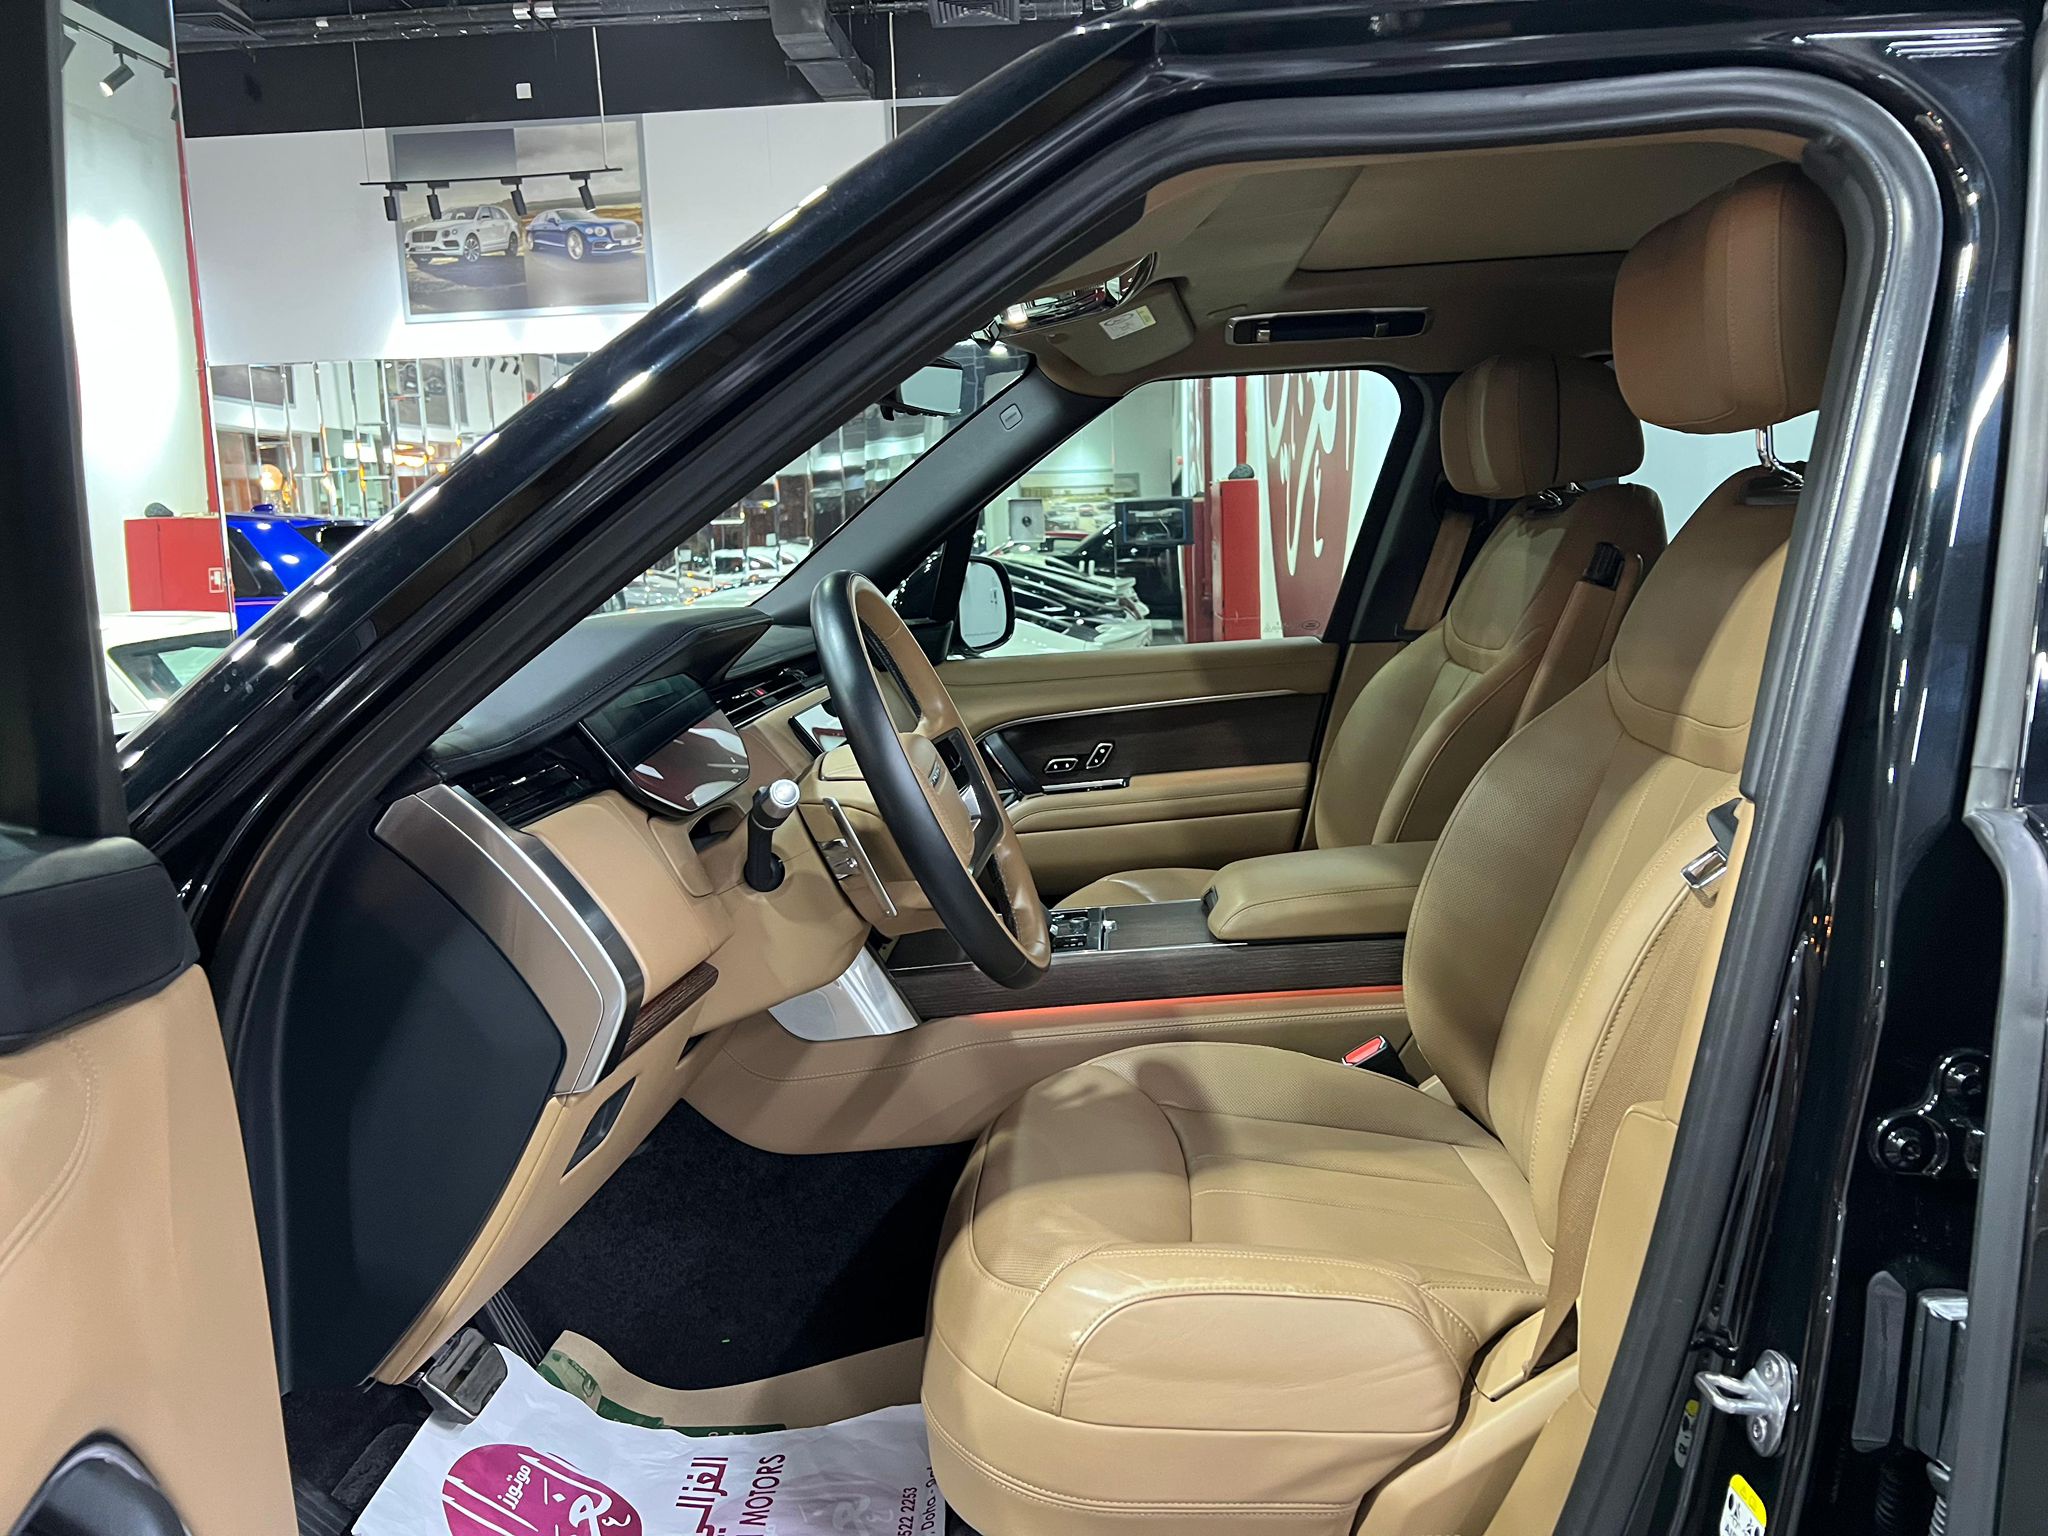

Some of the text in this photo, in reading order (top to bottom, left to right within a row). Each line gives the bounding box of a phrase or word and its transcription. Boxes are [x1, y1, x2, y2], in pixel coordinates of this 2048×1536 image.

[495, 1464, 532, 1510] موتورز
[739, 1454, 786, 1526] MOTORS
[900, 1487, 917, 1513] 2253
[920, 1496, 936, 1531] Doha
